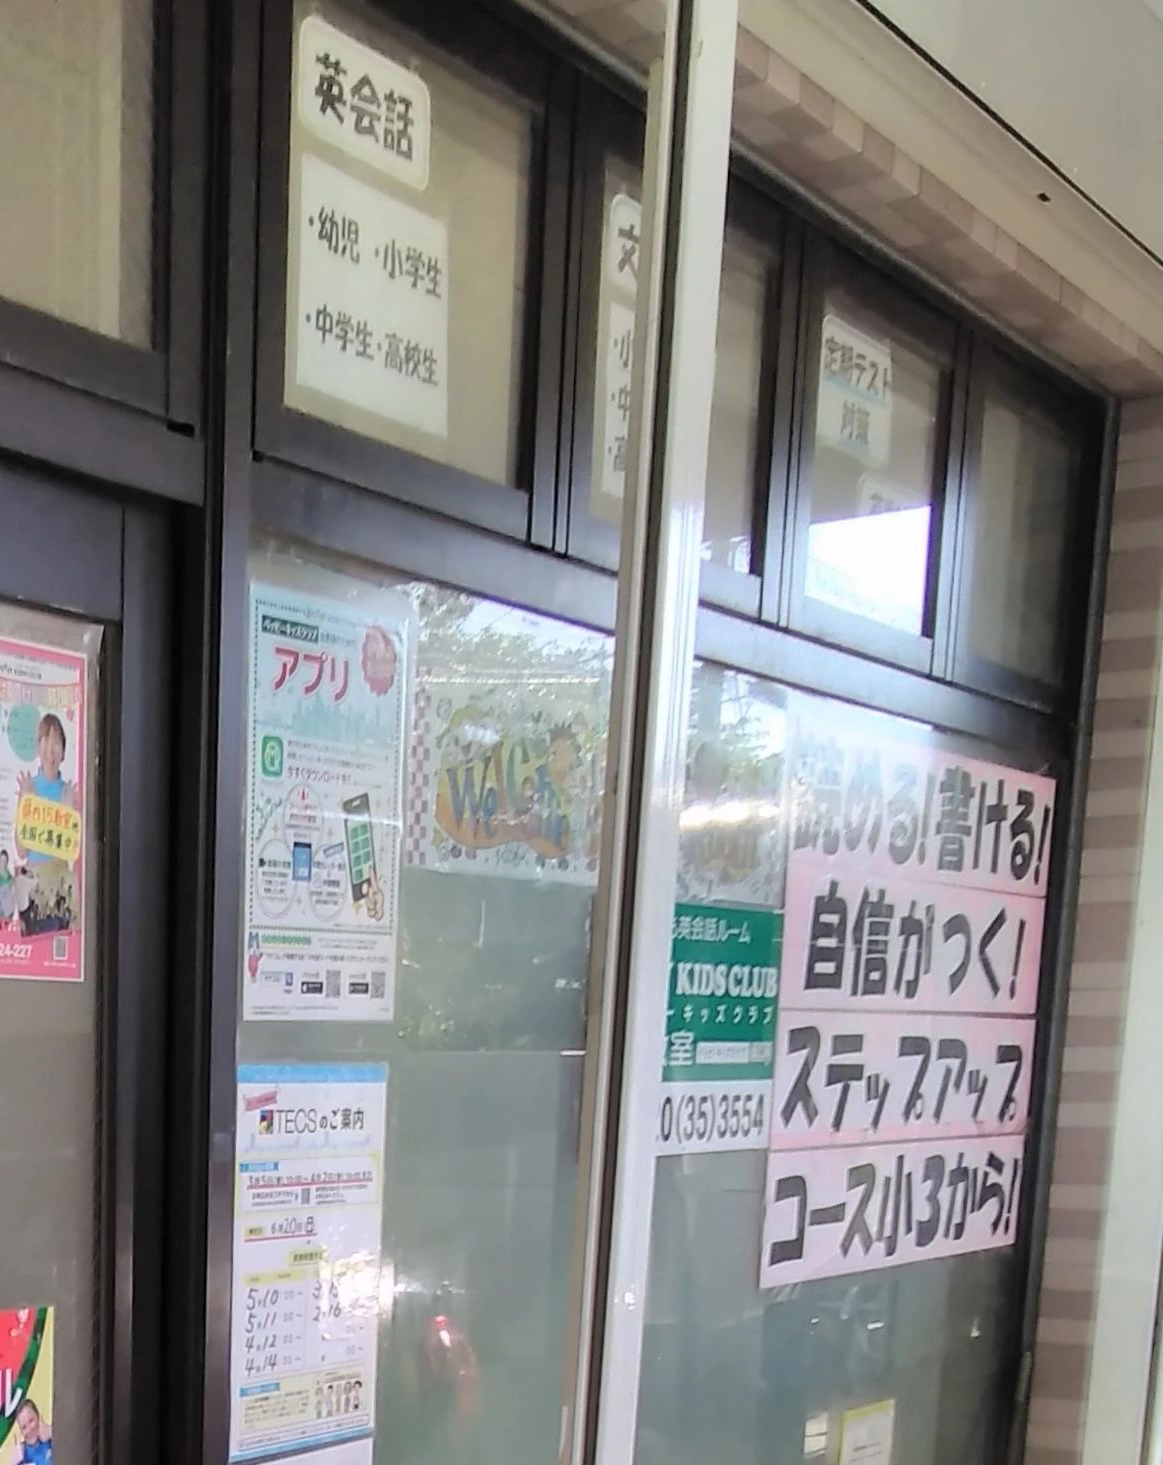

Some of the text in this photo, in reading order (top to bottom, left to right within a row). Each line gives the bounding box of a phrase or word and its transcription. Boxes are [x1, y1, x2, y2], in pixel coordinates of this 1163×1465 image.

[315, 52, 415, 163] 英会話
[272, 646, 349, 703] アプリ
[676, 961, 778, 998] KIDS CLUB
[803, 881, 1027, 1000] 自信がつく!
[663, 1030, 694, 1066] 室
[779, 1025, 1025, 1134] ステップアップ
[657, 1094, 764, 1144] 0(35)3554
[769, 1151, 1024, 1267] コース小3から!
